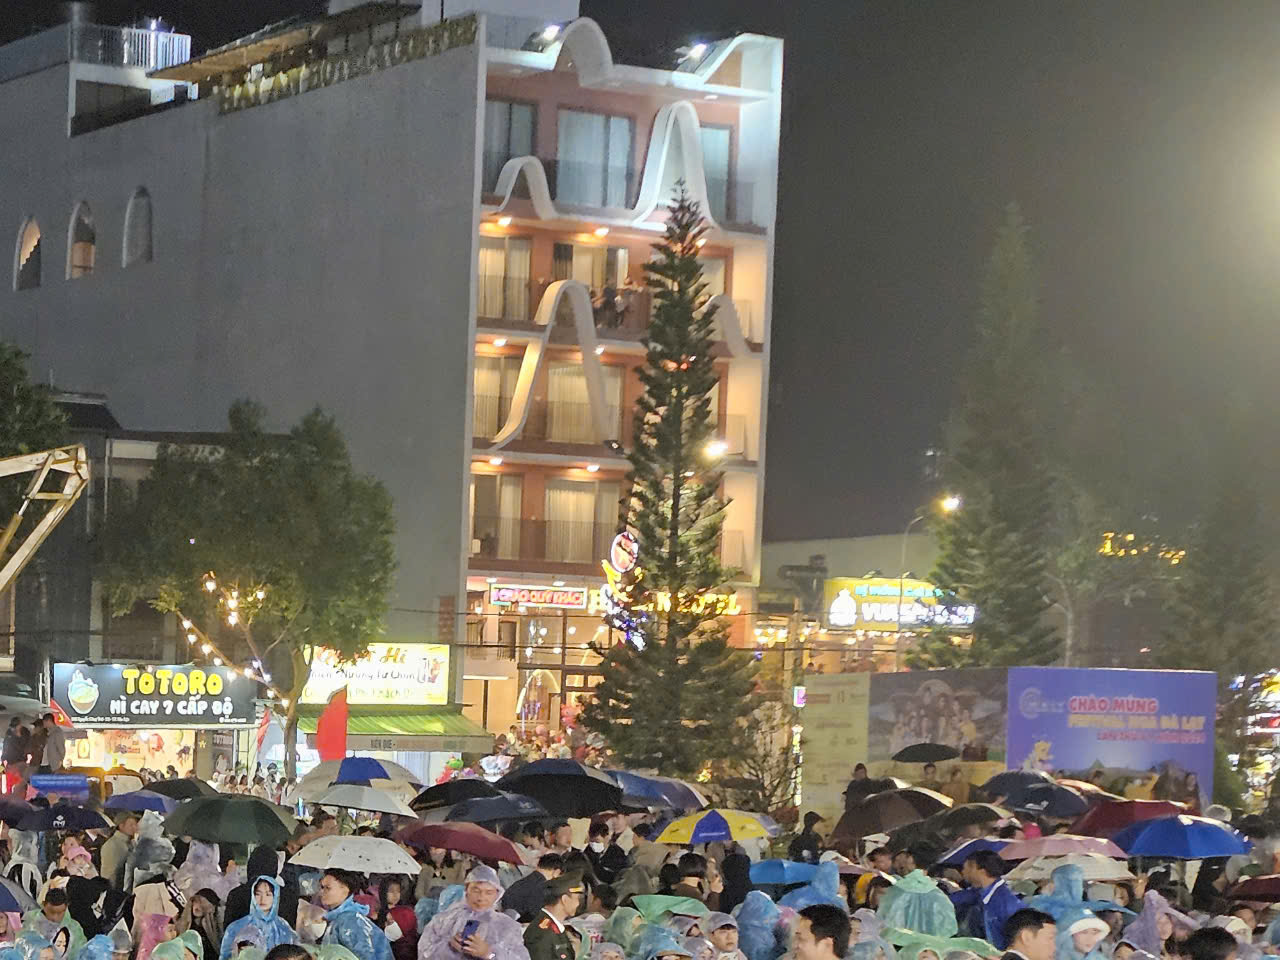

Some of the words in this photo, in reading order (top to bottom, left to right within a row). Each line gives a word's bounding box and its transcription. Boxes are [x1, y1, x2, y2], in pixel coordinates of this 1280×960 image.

[130, 700, 159, 715] CAY
[163, 700, 173, 715] 7
[177, 694, 208, 715] CẤP
[211, 696, 233, 718] ĐỘ
[1069, 694, 1110, 713] CHÀO
[1111, 694, 1158, 713] MỪNG
